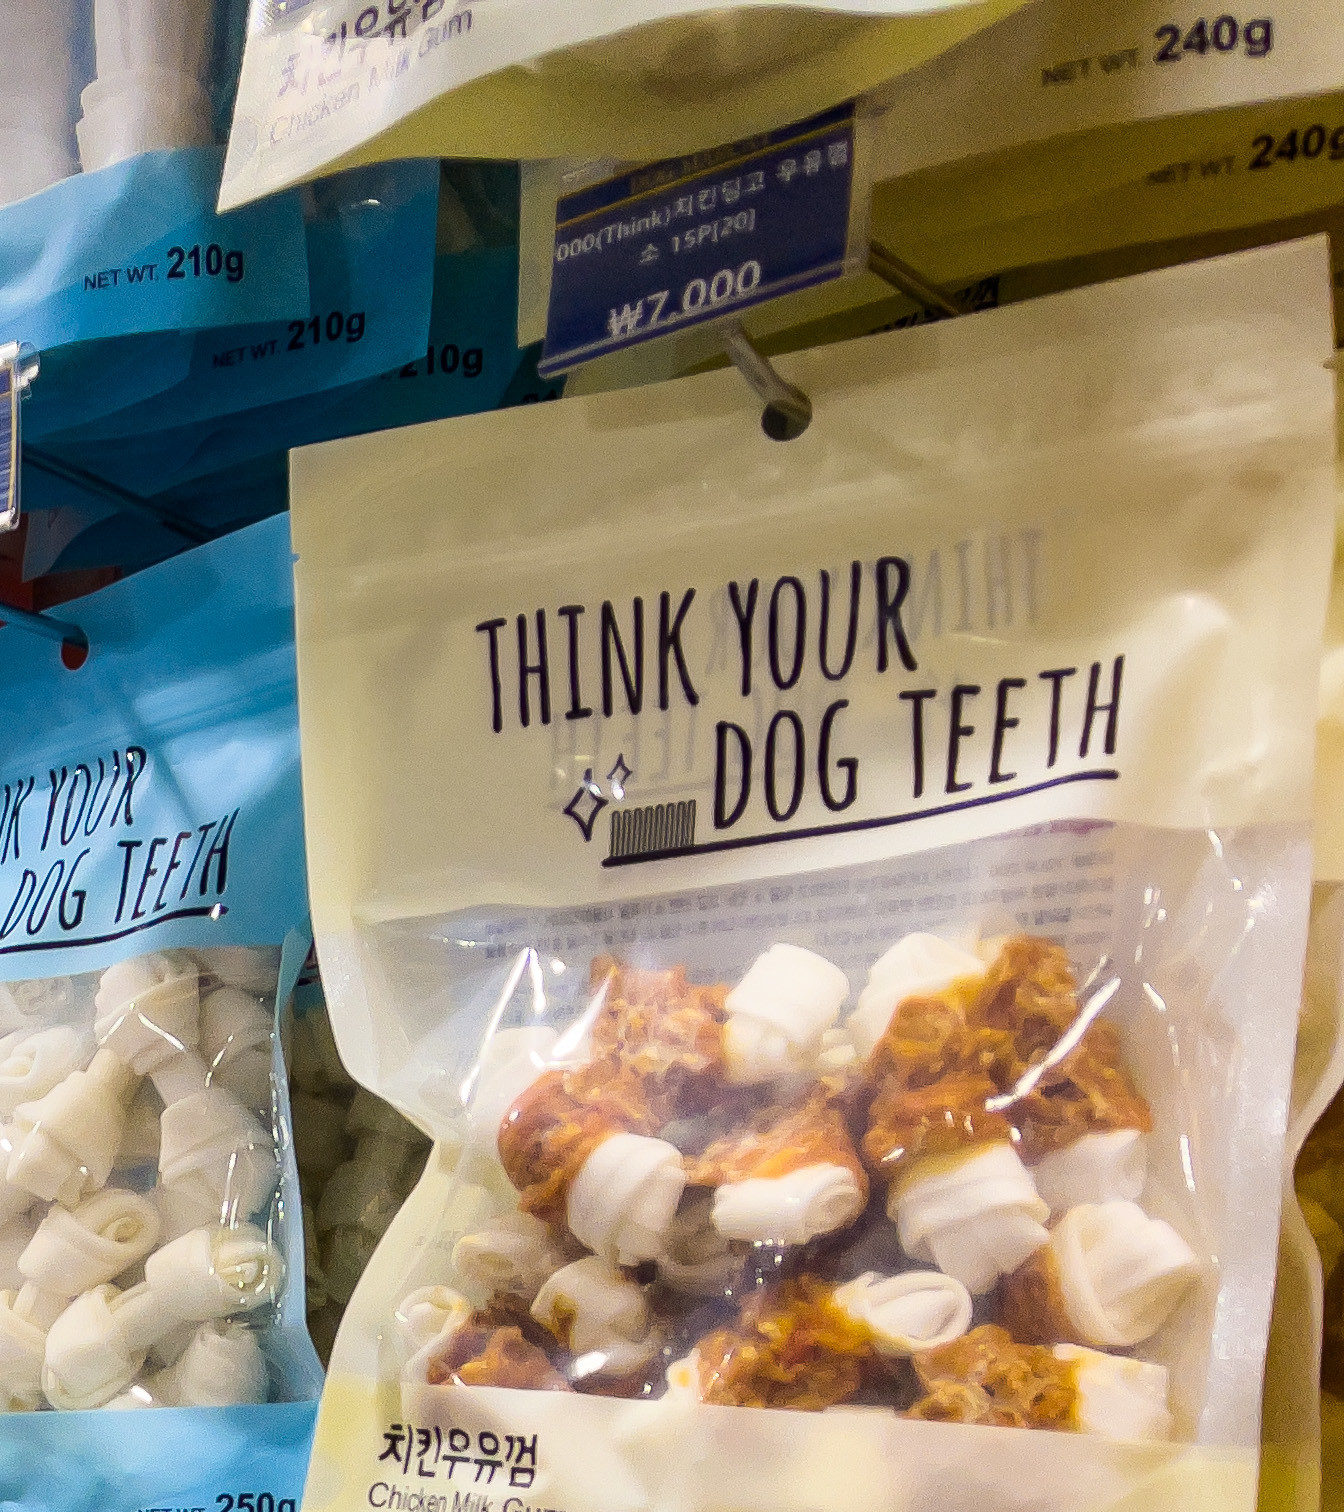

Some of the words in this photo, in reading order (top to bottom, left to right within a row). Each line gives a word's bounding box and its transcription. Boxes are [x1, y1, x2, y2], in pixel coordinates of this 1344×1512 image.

[1154, 15, 1273, 64] 240g
[84, 269, 123, 291] NET
[166, 245, 245, 282] 210g
[287, 310, 365, 351] 210g
[475, 588, 700, 734] THINK
[727, 557, 918, 694] YOUR
[712, 707, 860, 831] DOG
[900, 654, 1124, 802] TEETH
[43, 746, 147, 852] YOUR
[115, 808, 240, 926] TEETH
[376, 1423, 538, 1488] 치킨우유껌
